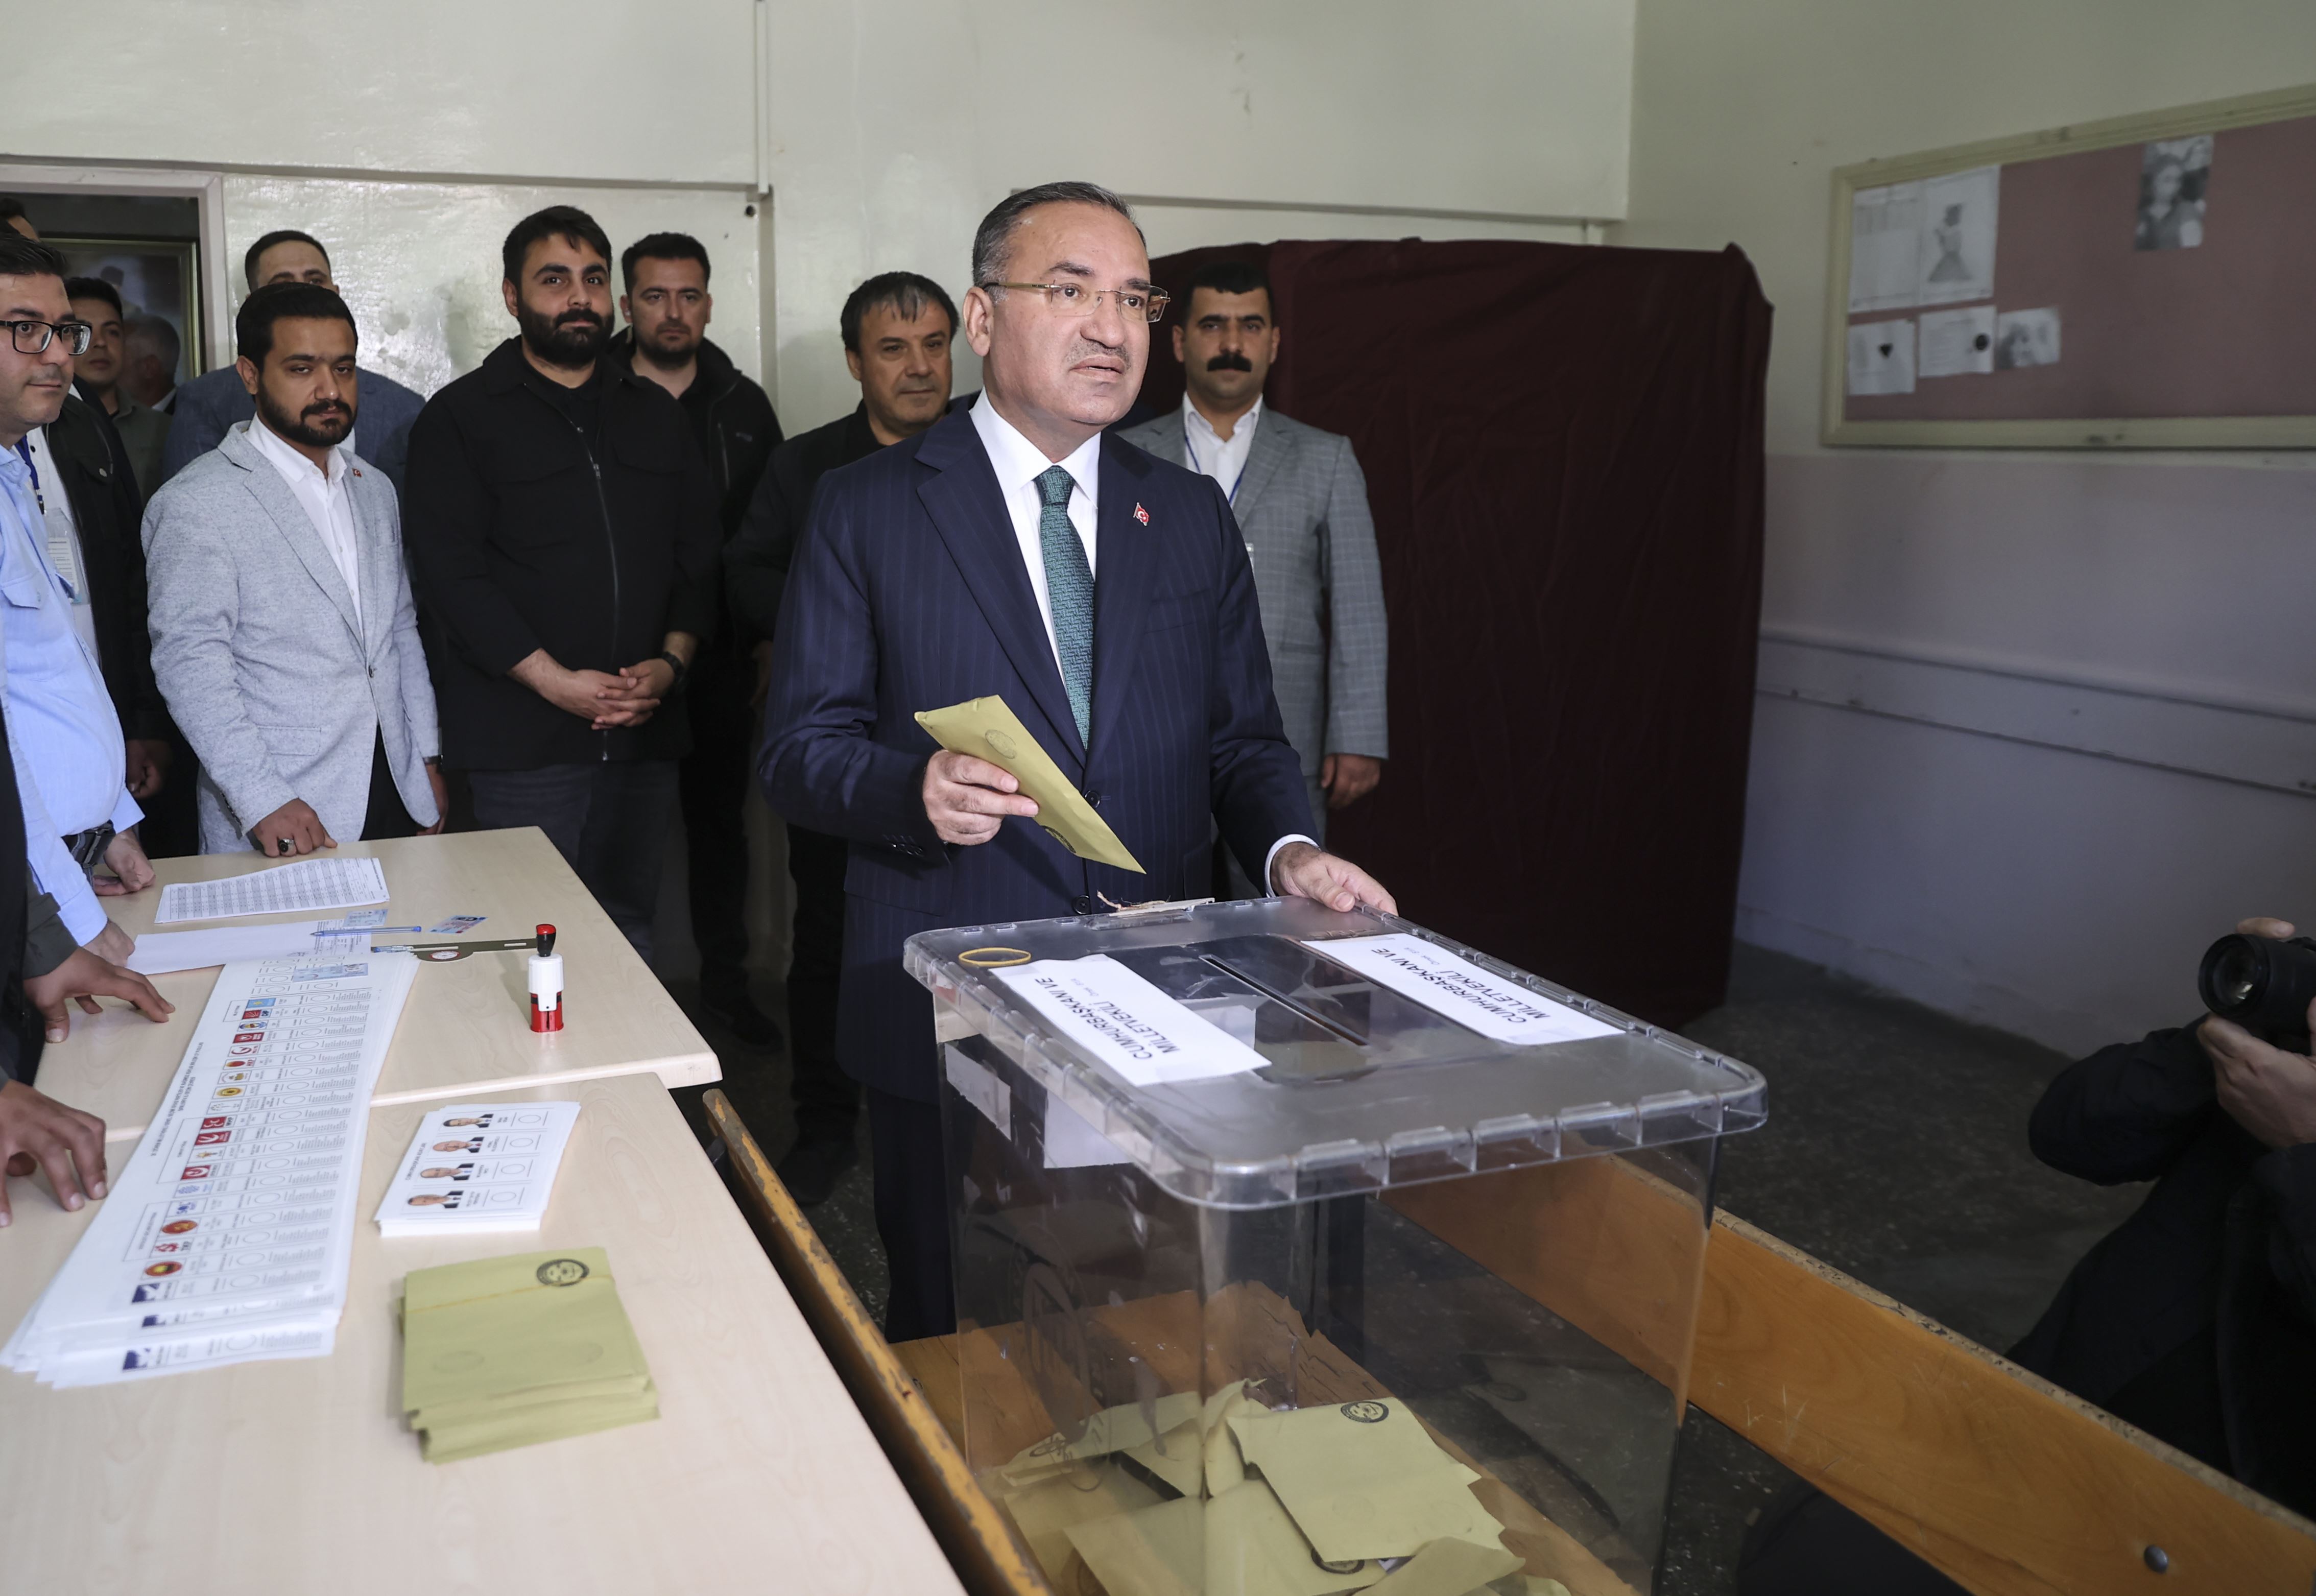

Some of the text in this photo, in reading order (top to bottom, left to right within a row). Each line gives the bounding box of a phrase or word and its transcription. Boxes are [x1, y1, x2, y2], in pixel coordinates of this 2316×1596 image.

[1034, 977, 1058, 989] VE
[1371, 947, 1527, 1023] CUMHURBAŞKANI VE
[1435, 970, 1550, 1019] MİLLETVEKİLİ
[1049, 990, 1153, 1060] CUMHURBAŞKANI
[1088, 1001, 1180, 1054] MİLLETVEKİLİ
